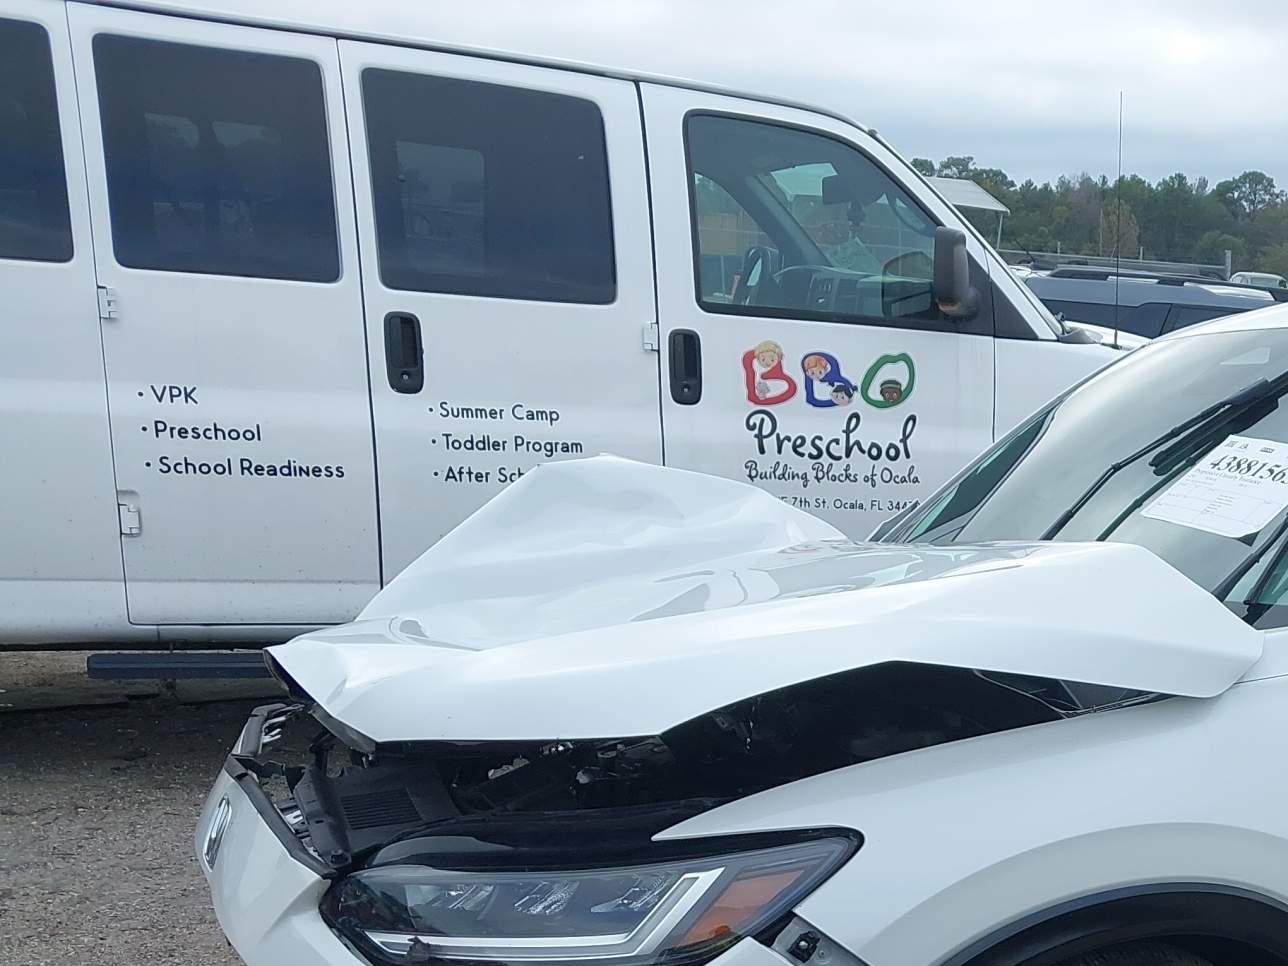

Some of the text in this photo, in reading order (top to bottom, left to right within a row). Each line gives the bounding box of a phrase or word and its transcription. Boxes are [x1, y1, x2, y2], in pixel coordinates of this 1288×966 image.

[150, 384, 198, 405] VPK
[439, 401, 560, 426] Summer Camp
[153, 420, 261, 442] Preschool
[745, 409, 917, 462] Preschool
[442, 433, 583, 458] Toddler Program
[158, 456, 345, 478] School Readiness
[444, 465, 491, 483] After
[744, 459, 921, 489] Building Blocks of Ocala
[791, 497, 811, 509] 7th
[814, 497, 830, 509] St.
[833, 498, 867, 512] Ocala,
[870, 499, 883, 511] FL
